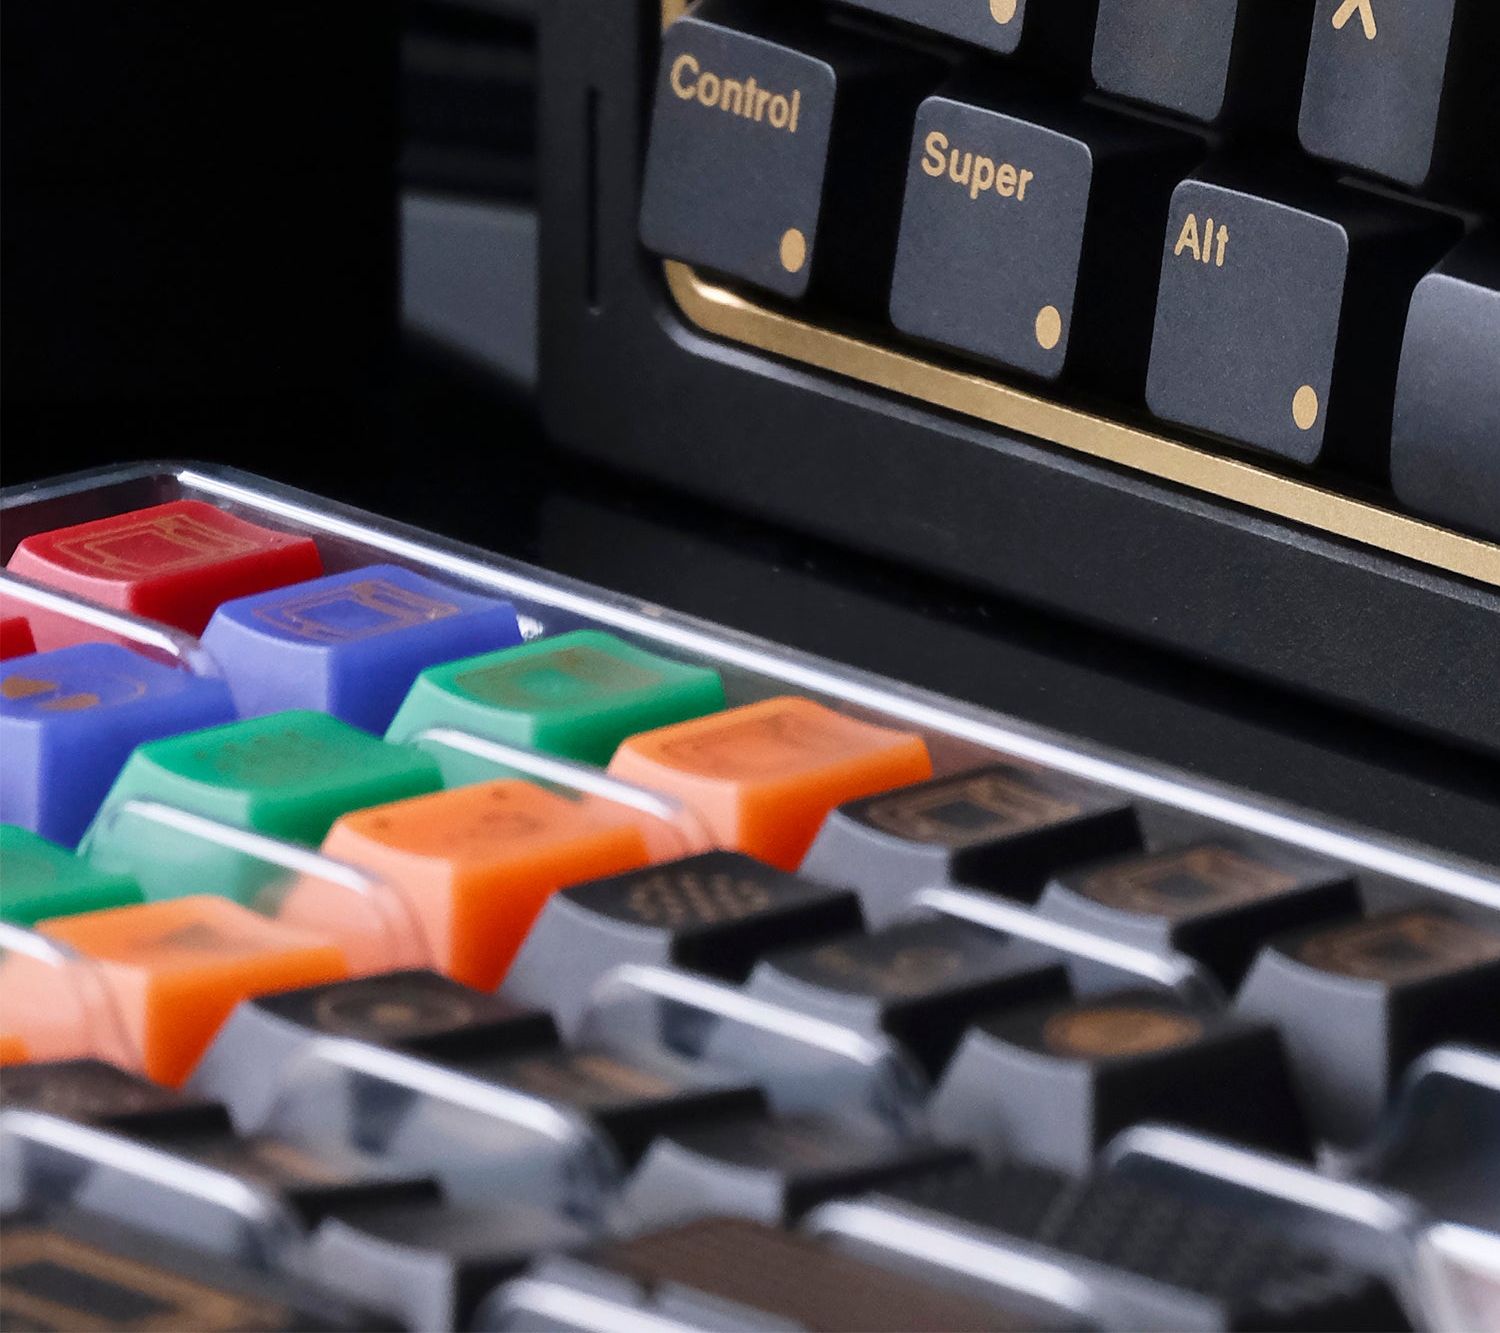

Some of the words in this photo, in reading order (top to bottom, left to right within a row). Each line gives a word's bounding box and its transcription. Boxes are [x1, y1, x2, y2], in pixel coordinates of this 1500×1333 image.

[669, 53, 801, 133] Control
[921, 130, 1034, 201] Super
[1174, 212, 1229, 266] Alt
